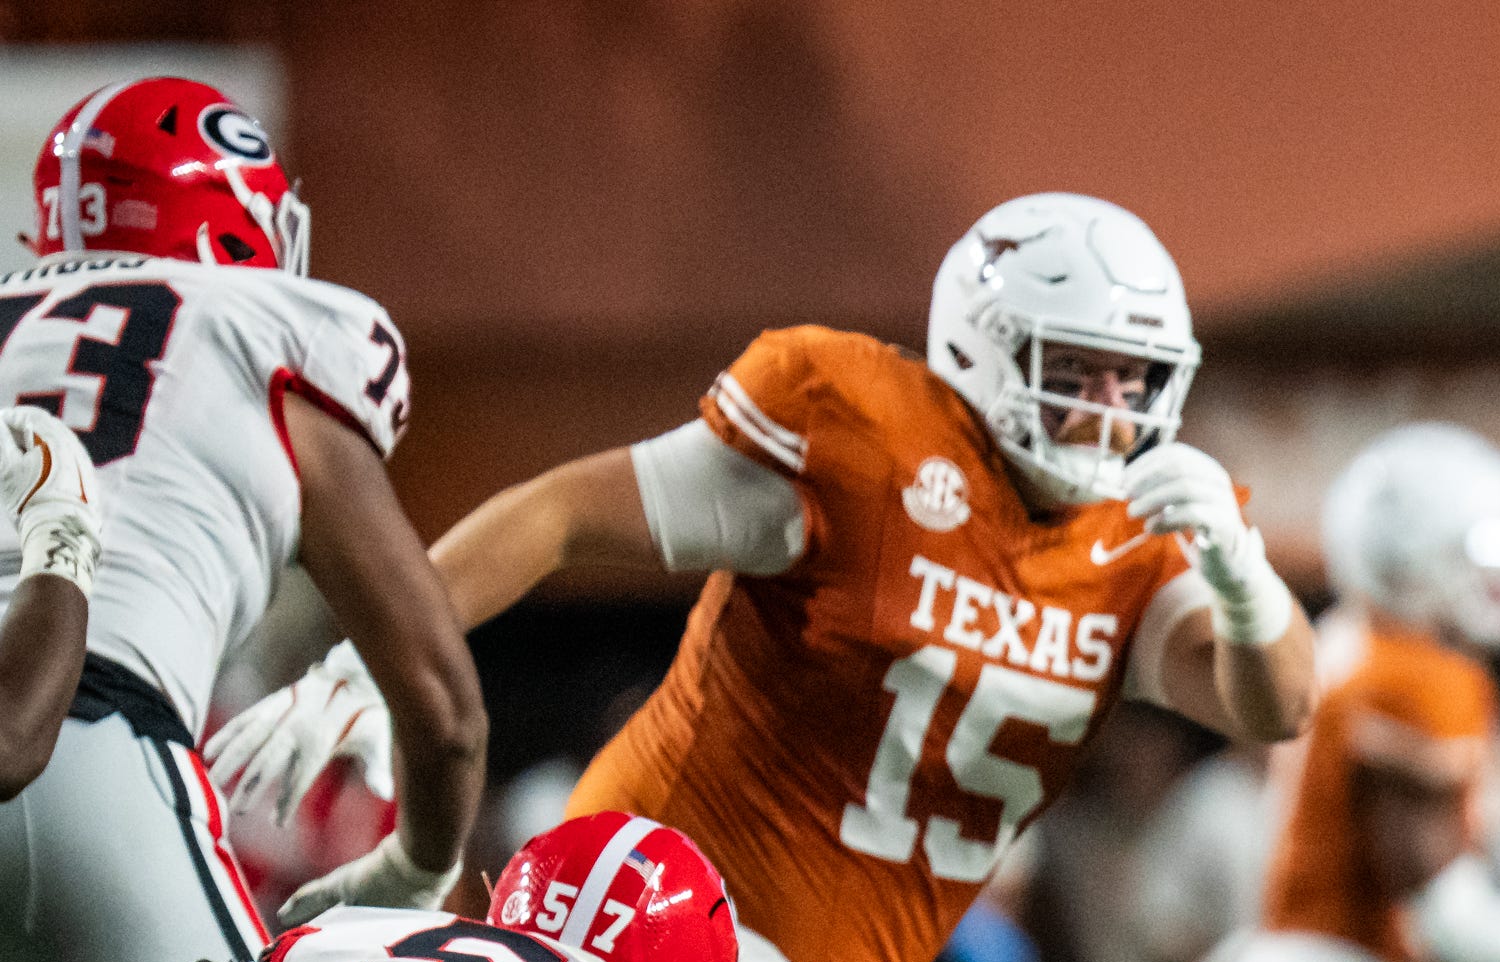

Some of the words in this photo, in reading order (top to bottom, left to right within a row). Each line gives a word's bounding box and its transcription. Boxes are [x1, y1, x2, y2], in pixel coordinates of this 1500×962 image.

[203, 108, 269, 160] G
[43, 182, 107, 240] 73
[909, 554, 1118, 682] TEXAS
[840, 646, 1097, 883] 15
[535, 880, 635, 954] 57
